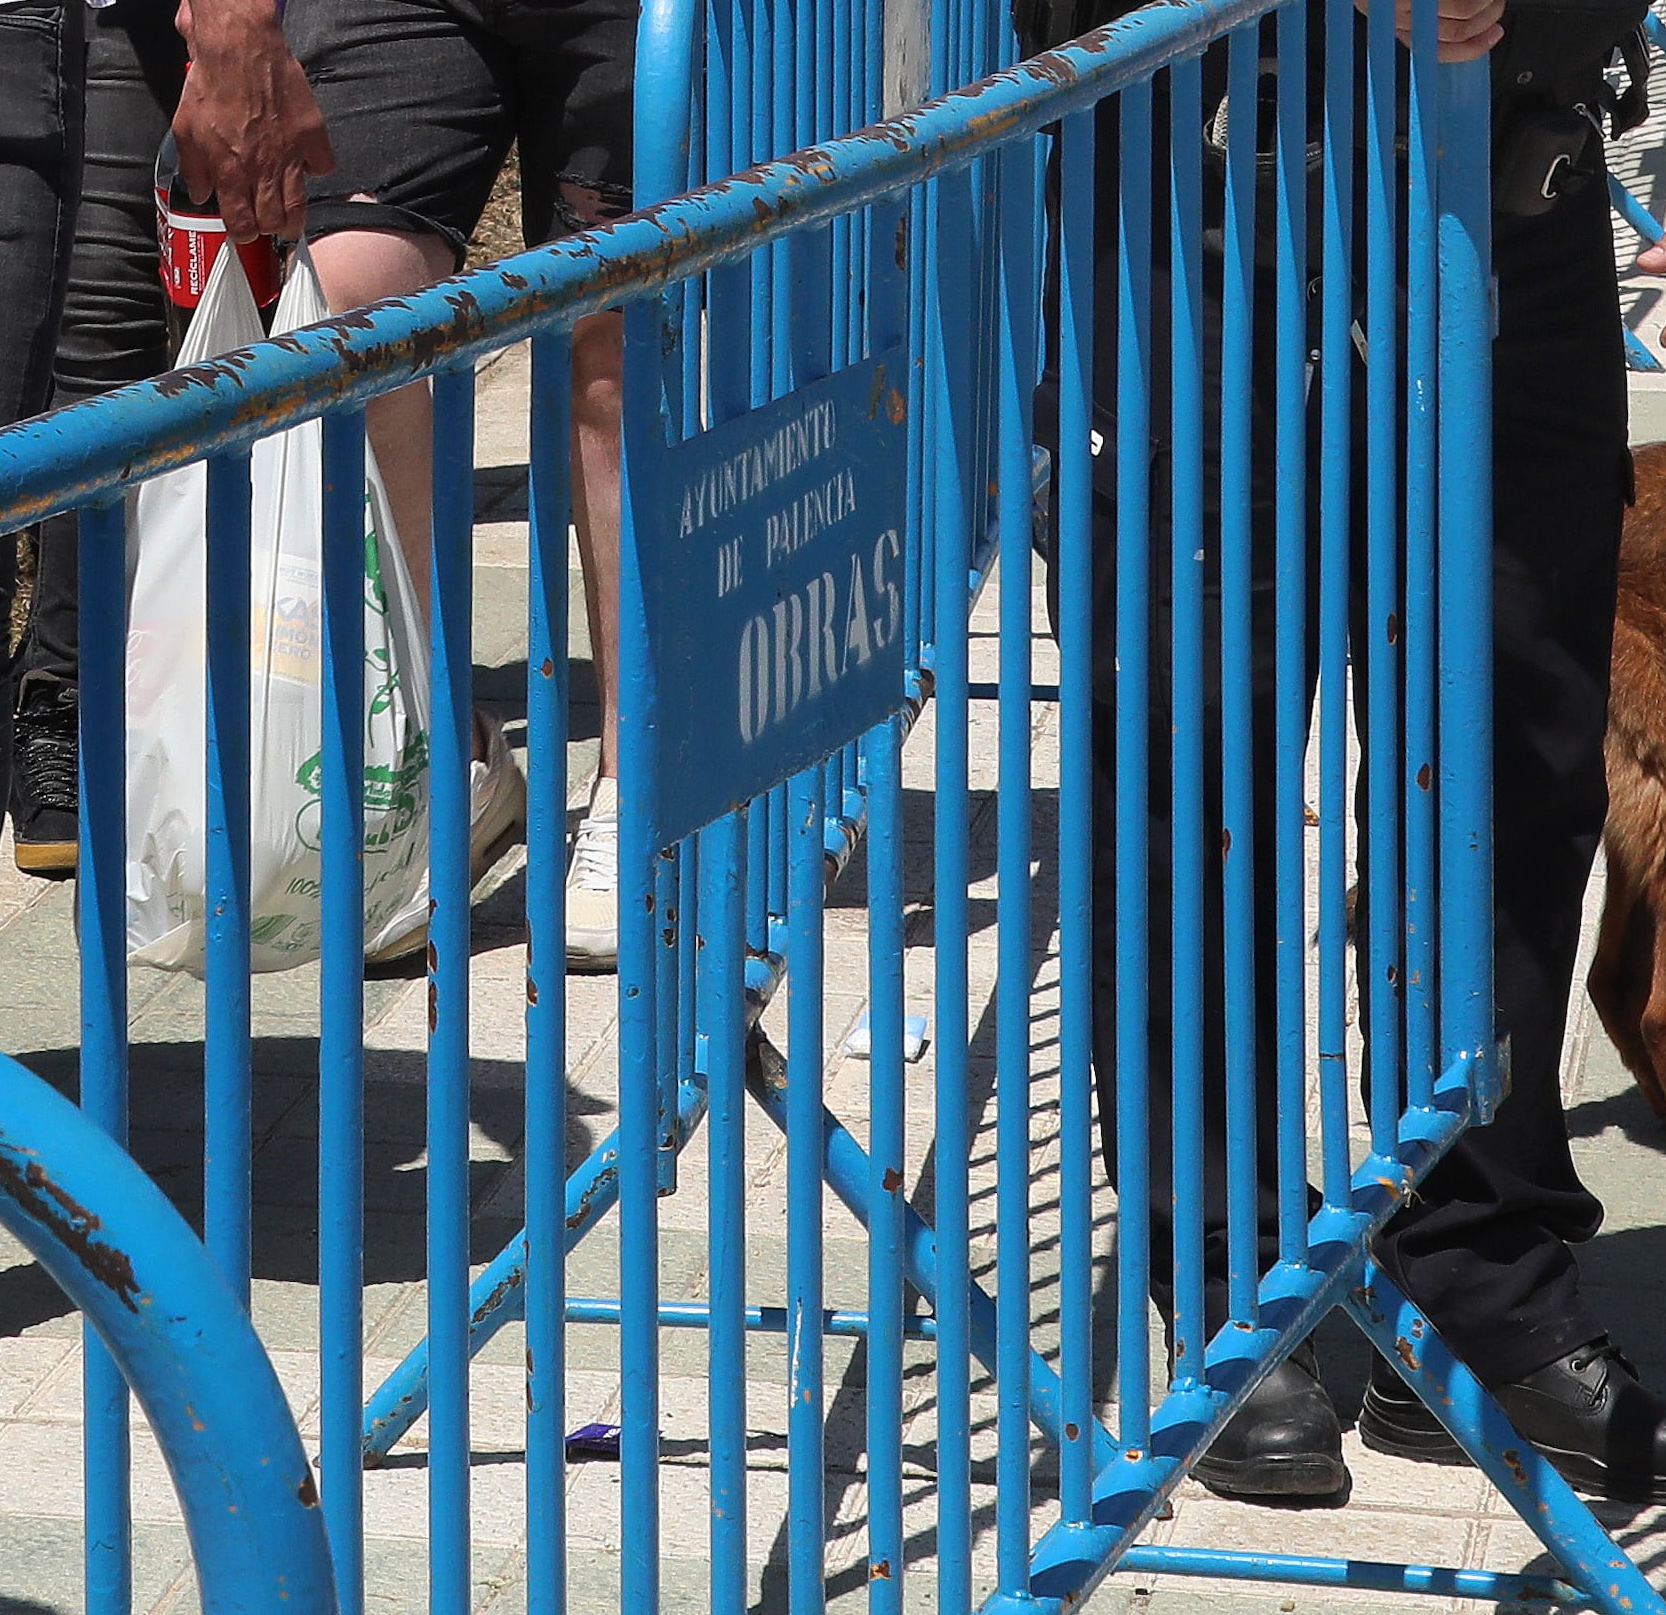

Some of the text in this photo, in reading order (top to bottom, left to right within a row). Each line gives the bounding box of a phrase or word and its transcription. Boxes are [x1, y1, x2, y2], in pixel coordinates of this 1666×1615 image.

[679, 400, 836, 539] AYUNTAMIENTO
[717, 468, 856, 597] DE PALENCIA
[738, 529, 901, 744] OBRAS
